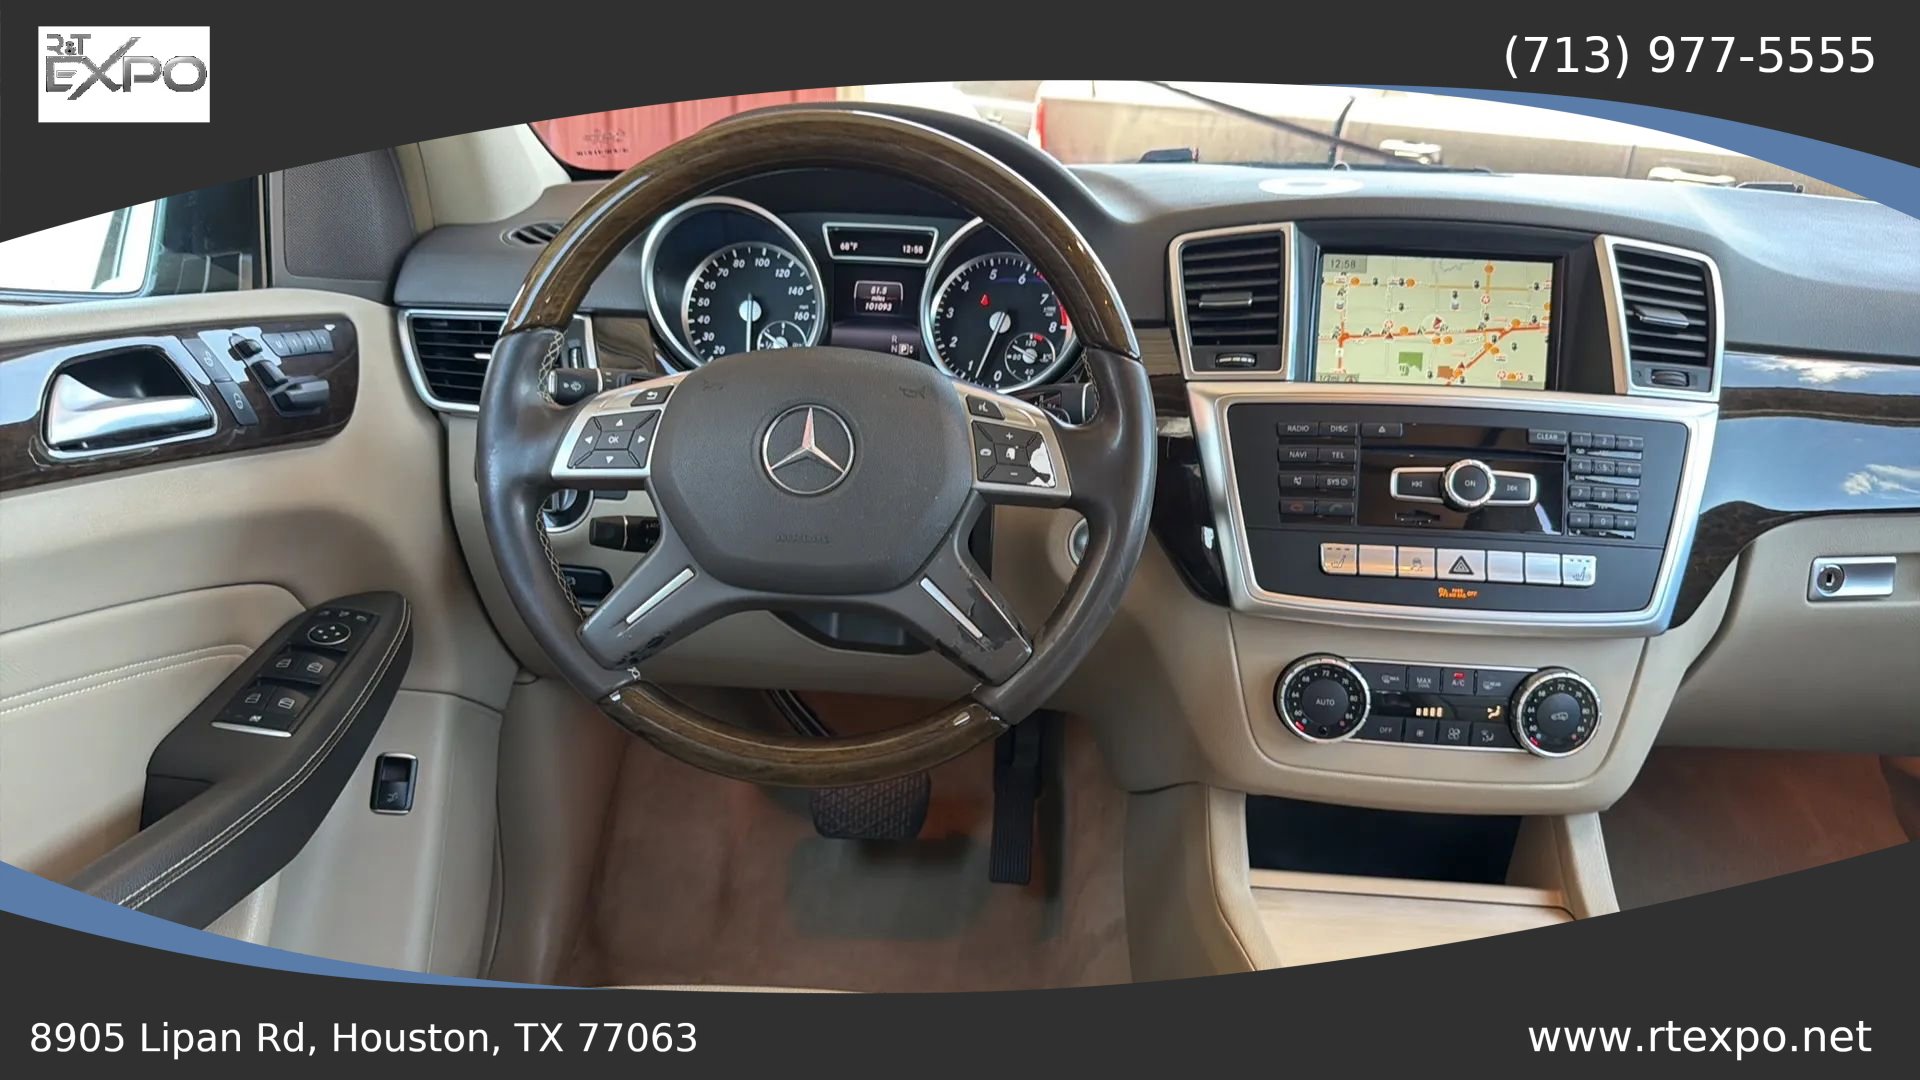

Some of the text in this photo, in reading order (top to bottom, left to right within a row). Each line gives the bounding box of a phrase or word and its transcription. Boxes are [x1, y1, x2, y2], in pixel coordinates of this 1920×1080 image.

[733, 258, 745, 268] 80
[755, 257, 770, 268] 100
[1330, 259, 1356, 269] 12:58
[717, 268, 729, 278] 70
[775, 268, 790, 279] 120
[989, 269, 998, 280] 5
[1018, 273, 1026, 285] 6
[704, 281, 716, 291] 60
[788, 286, 804, 296] 140
[961, 281, 970, 292] 4
[697, 297, 710, 307] 50
[1040, 294, 1049, 305] 7
[794, 311, 810, 321] 160
[946, 307, 955, 319] 3
[697, 315, 710, 325] 40
[1048, 321, 1058, 333] 8
[702, 332, 715, 342] 30
[949, 336, 958, 348] 2
[713, 344, 726, 355] 20
[967, 360, 974, 371] 1
[993, 370, 1002, 382] 0
[608, 435, 619, 444] OK
[1379, 726, 1392, 734] OFF
